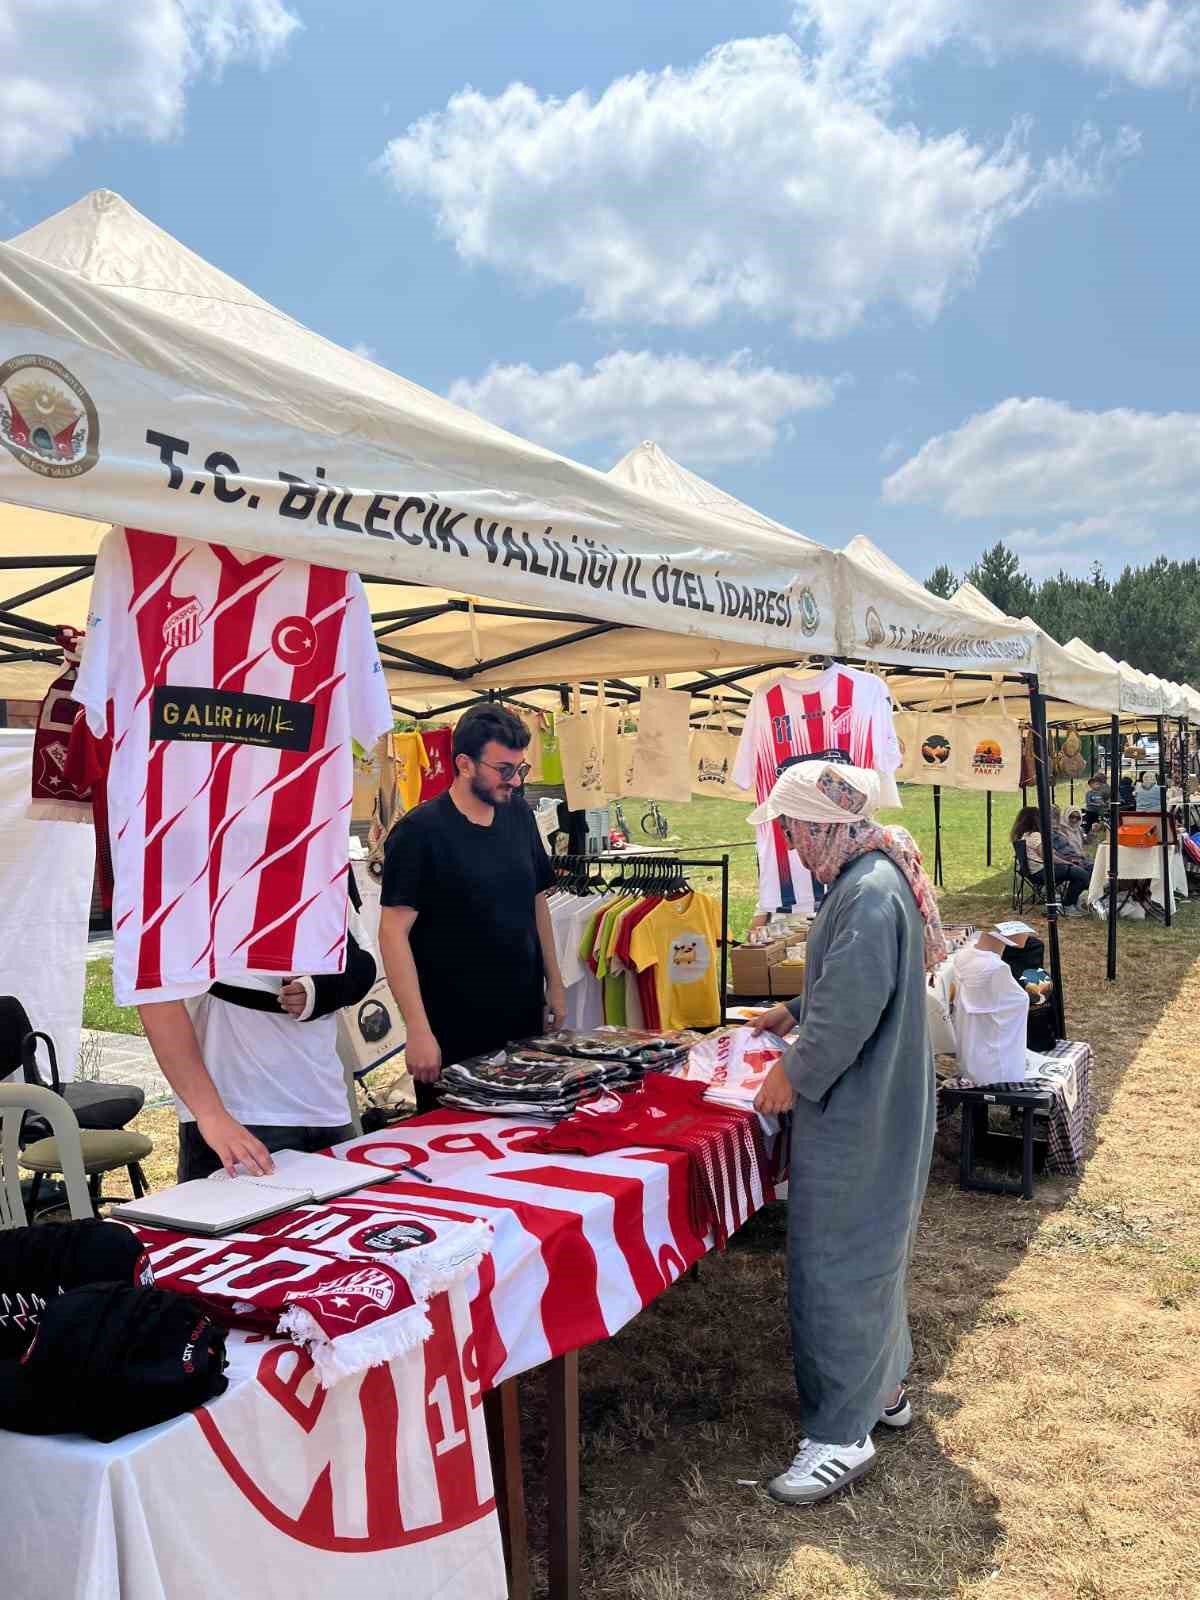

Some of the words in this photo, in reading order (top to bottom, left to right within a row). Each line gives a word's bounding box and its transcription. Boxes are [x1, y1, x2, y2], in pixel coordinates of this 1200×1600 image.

[145, 429, 260, 509] T.C.
[277, 466, 469, 558] BİLECİK
[474, 517, 617, 591] VALİLİĞİ
[620, 549, 646, 598] İL
[652, 555, 714, 612] ÖZEL
[714, 571, 792, 628] İDARESİ
[182, 1342, 195, 1362] CITY
